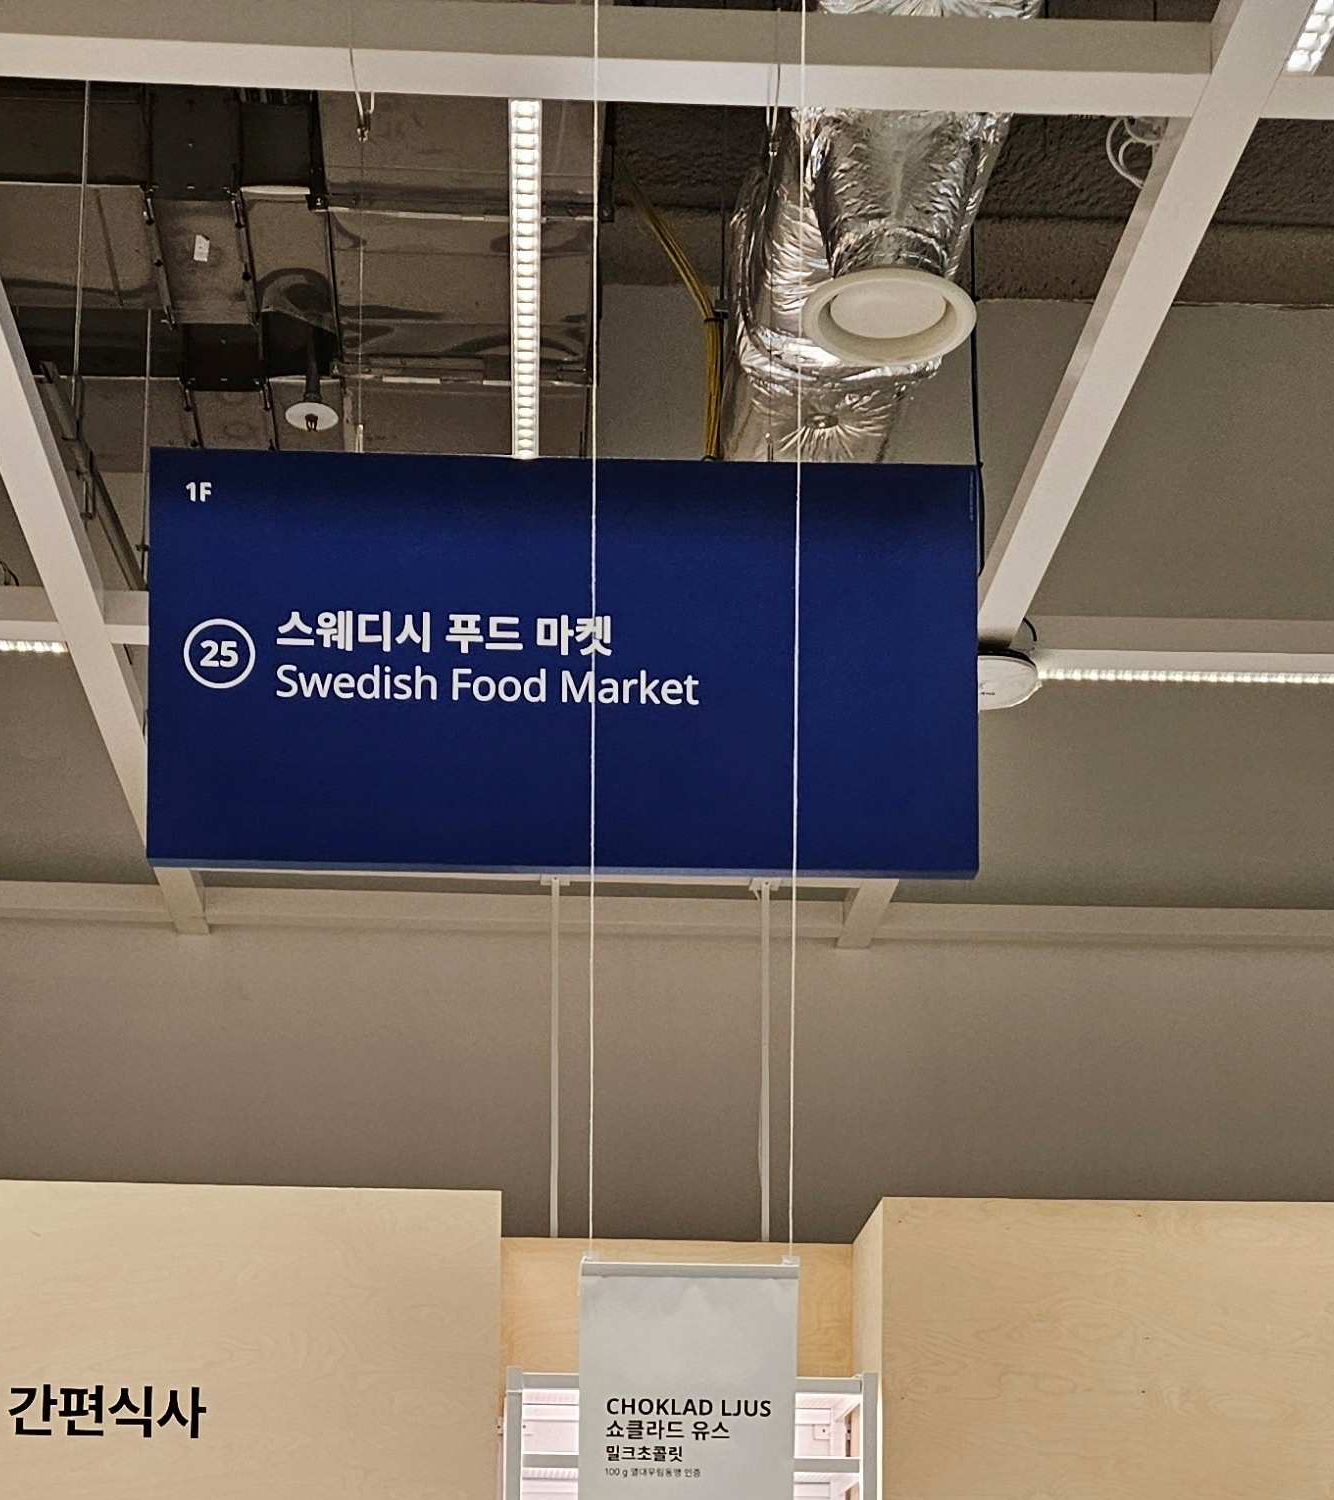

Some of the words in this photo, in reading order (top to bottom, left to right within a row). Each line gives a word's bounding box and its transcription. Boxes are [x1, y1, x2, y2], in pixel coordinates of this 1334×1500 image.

[185, 482, 212, 502] 1F
[276, 610, 431, 652] 스웨디시
[445, 614, 522, 653] 푸드
[536, 615, 612, 657] 마켓
[199, 640, 239, 669] 25
[275, 665, 437, 701] Swedish
[451, 667, 546, 703] Food
[560, 671, 699, 706] Market
[8, 1384, 207, 1439] 간편식사
[607, 1398, 713, 1416] CHOKLAD
[721, 1399, 771, 1418] LJUS
[606, 1420, 684, 1440] 쇼클라드
[691, 1421, 730, 1441] 유스
[606, 1445, 683, 1462] 밀크초콜릿
[605, 1468, 620, 1476] 100
[622, 1469, 628, 1478] g
